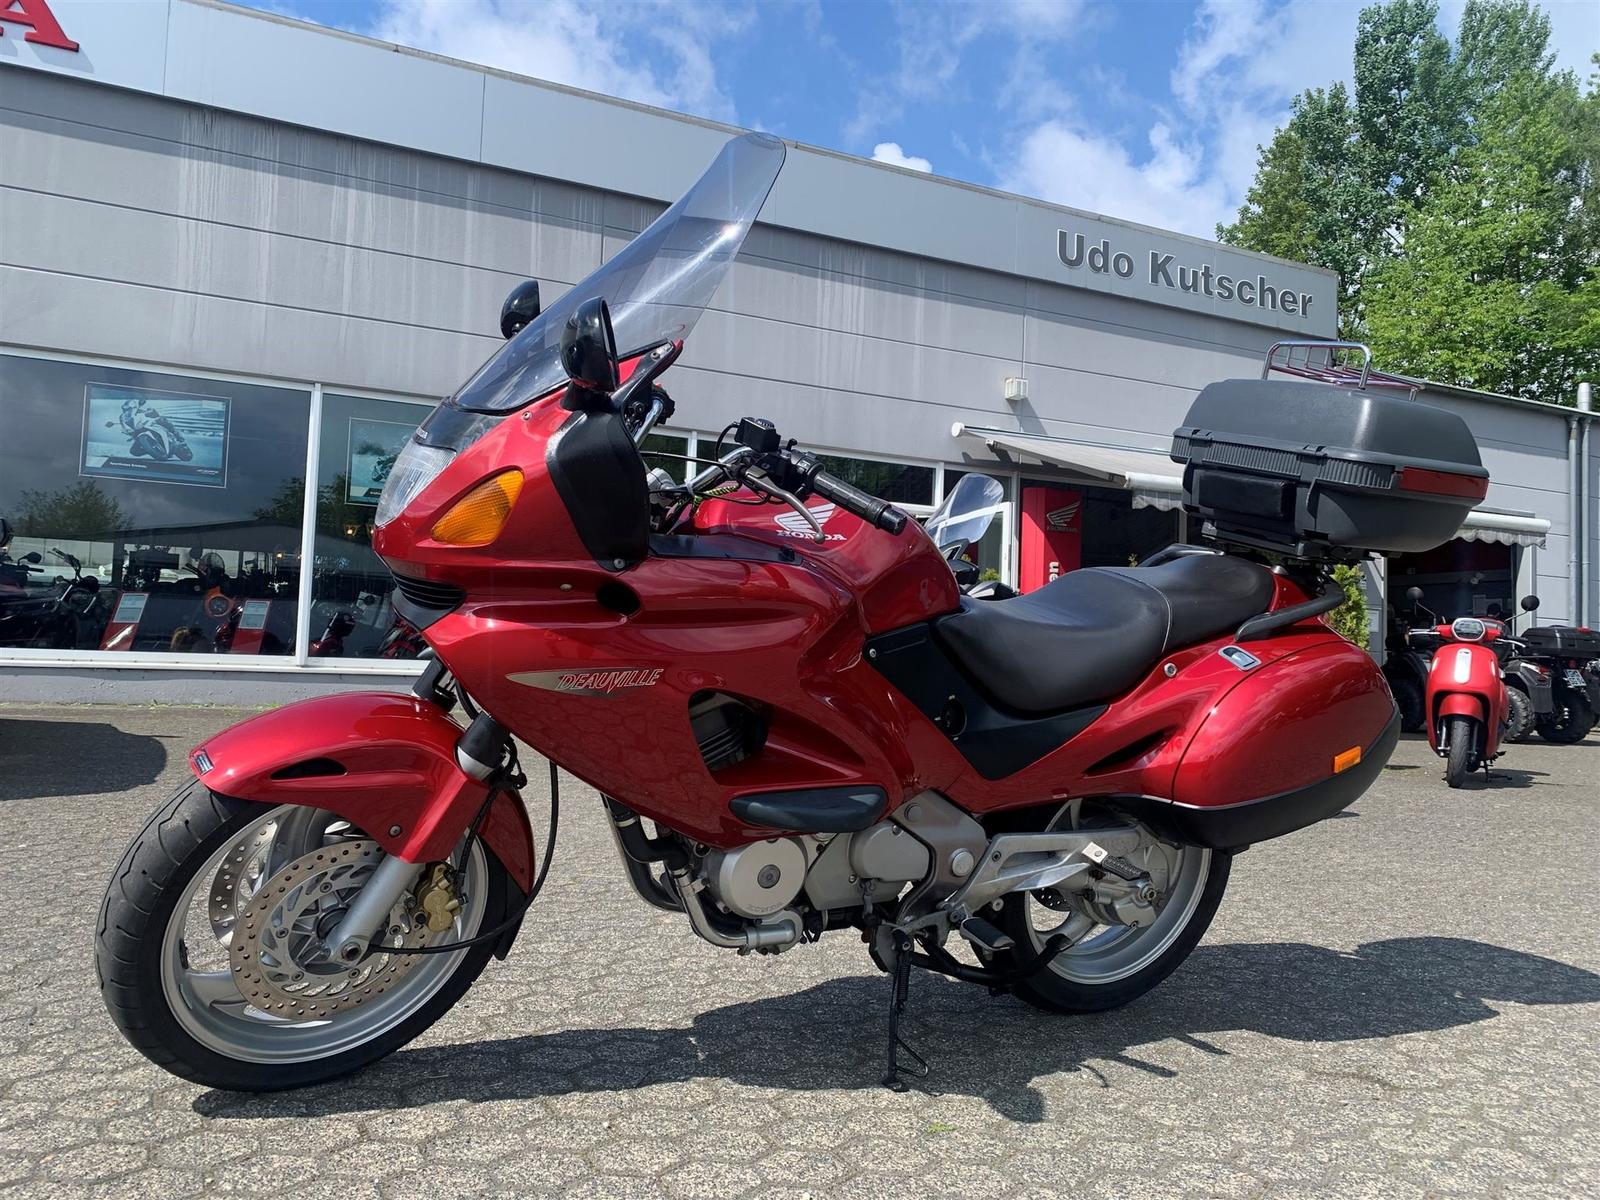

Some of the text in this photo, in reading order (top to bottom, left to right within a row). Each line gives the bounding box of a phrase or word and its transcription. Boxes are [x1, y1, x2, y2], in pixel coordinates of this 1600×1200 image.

[1056, 228, 1313, 318] Udo Kutscher
[555, 668, 664, 694] DEAUVILLE
